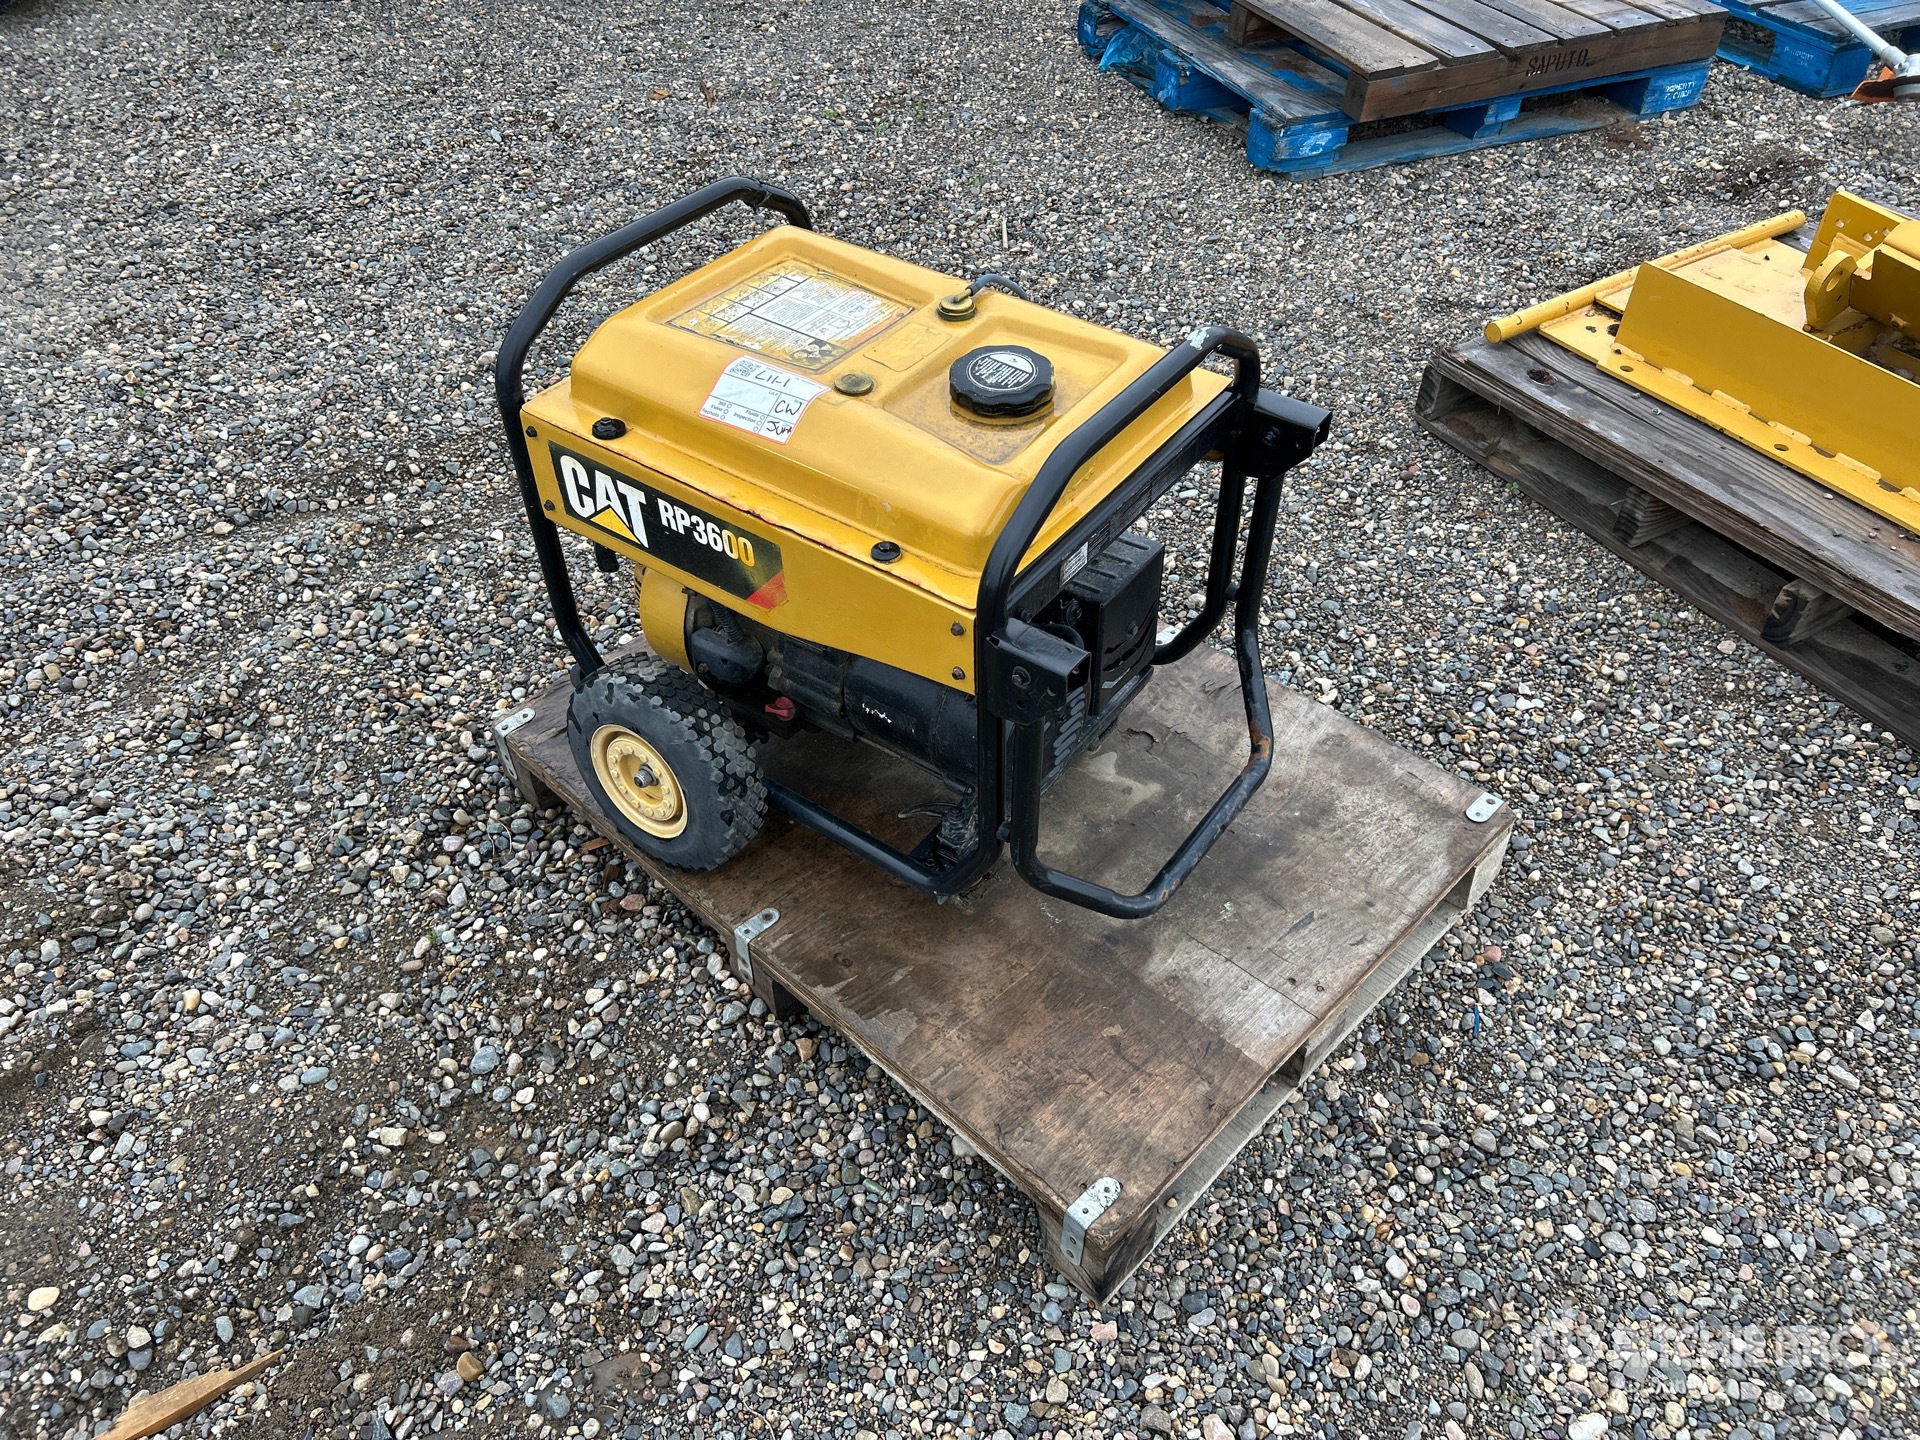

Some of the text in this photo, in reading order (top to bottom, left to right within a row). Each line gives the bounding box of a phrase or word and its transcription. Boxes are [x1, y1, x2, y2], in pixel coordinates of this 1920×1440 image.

[1526, 48, 1588, 77] SAPUTO
[733, 412, 757, 423] Inspection
[774, 399, 803, 416] CW
[560, 455, 756, 567] CAT RP3600
